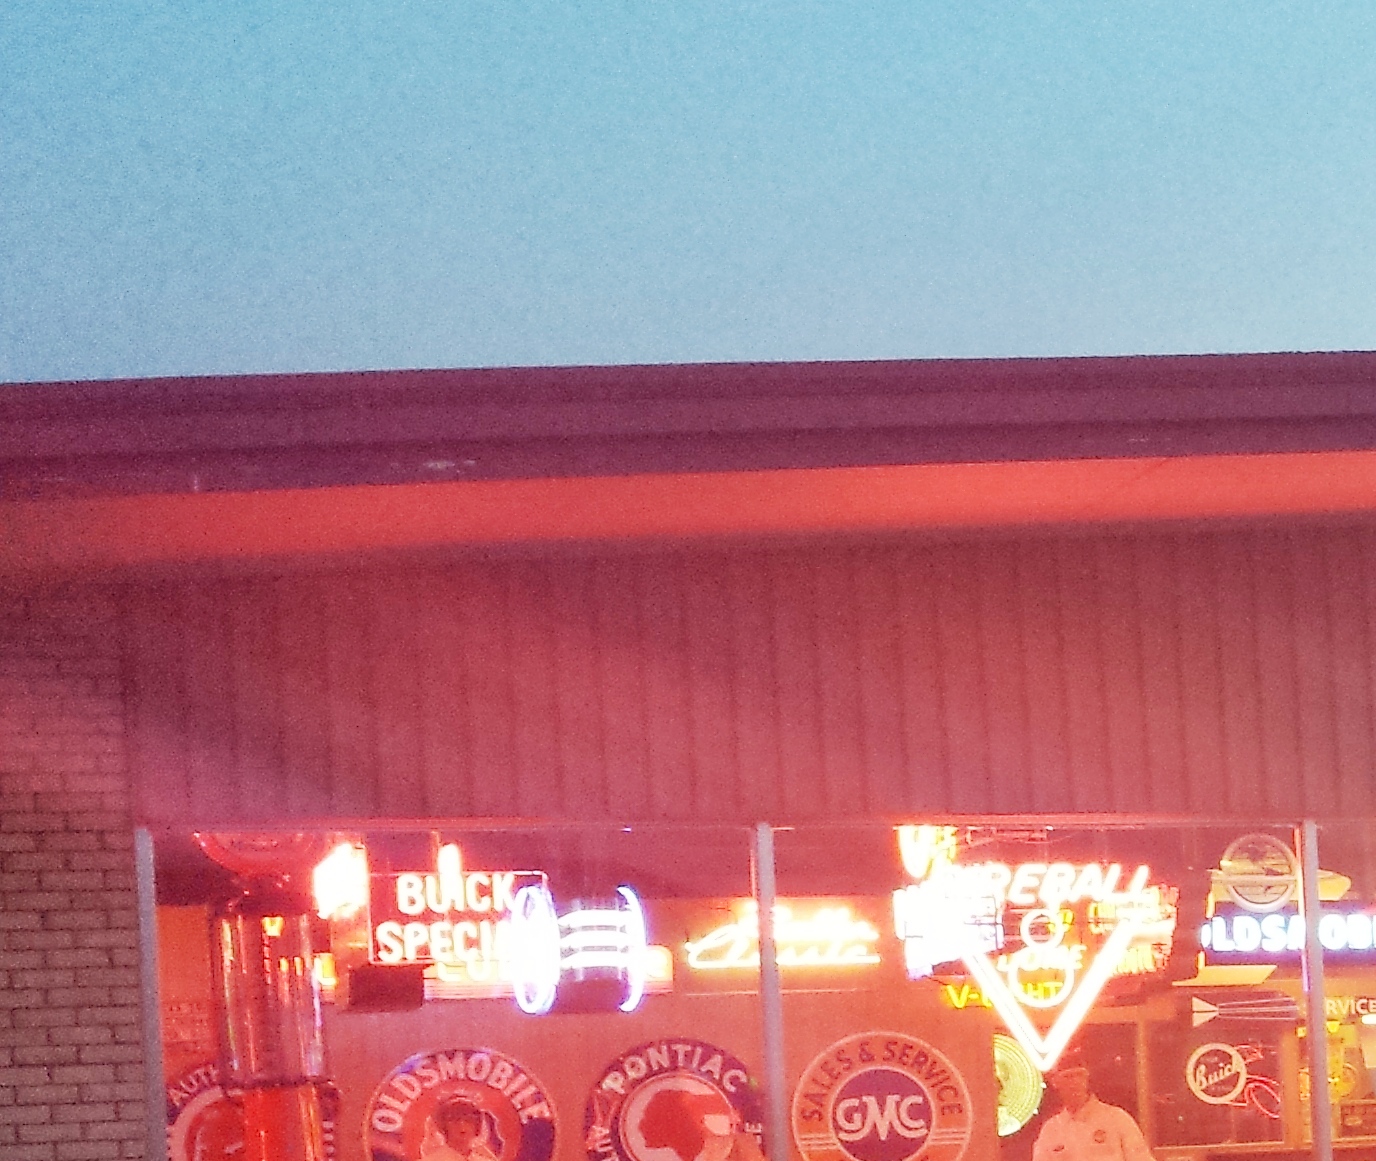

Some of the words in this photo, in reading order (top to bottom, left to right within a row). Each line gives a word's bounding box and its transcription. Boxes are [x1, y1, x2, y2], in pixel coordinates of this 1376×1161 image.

[396, 872, 515, 916] BUICK
[371, 1050, 556, 1134] OLDSMOBILE
[601, 1044, 750, 1096] PONTIAC
[802, 1048, 853, 1122] SALES
[882, 1041, 963, 1116] SERVICE
[835, 1094, 929, 1142] GMC
